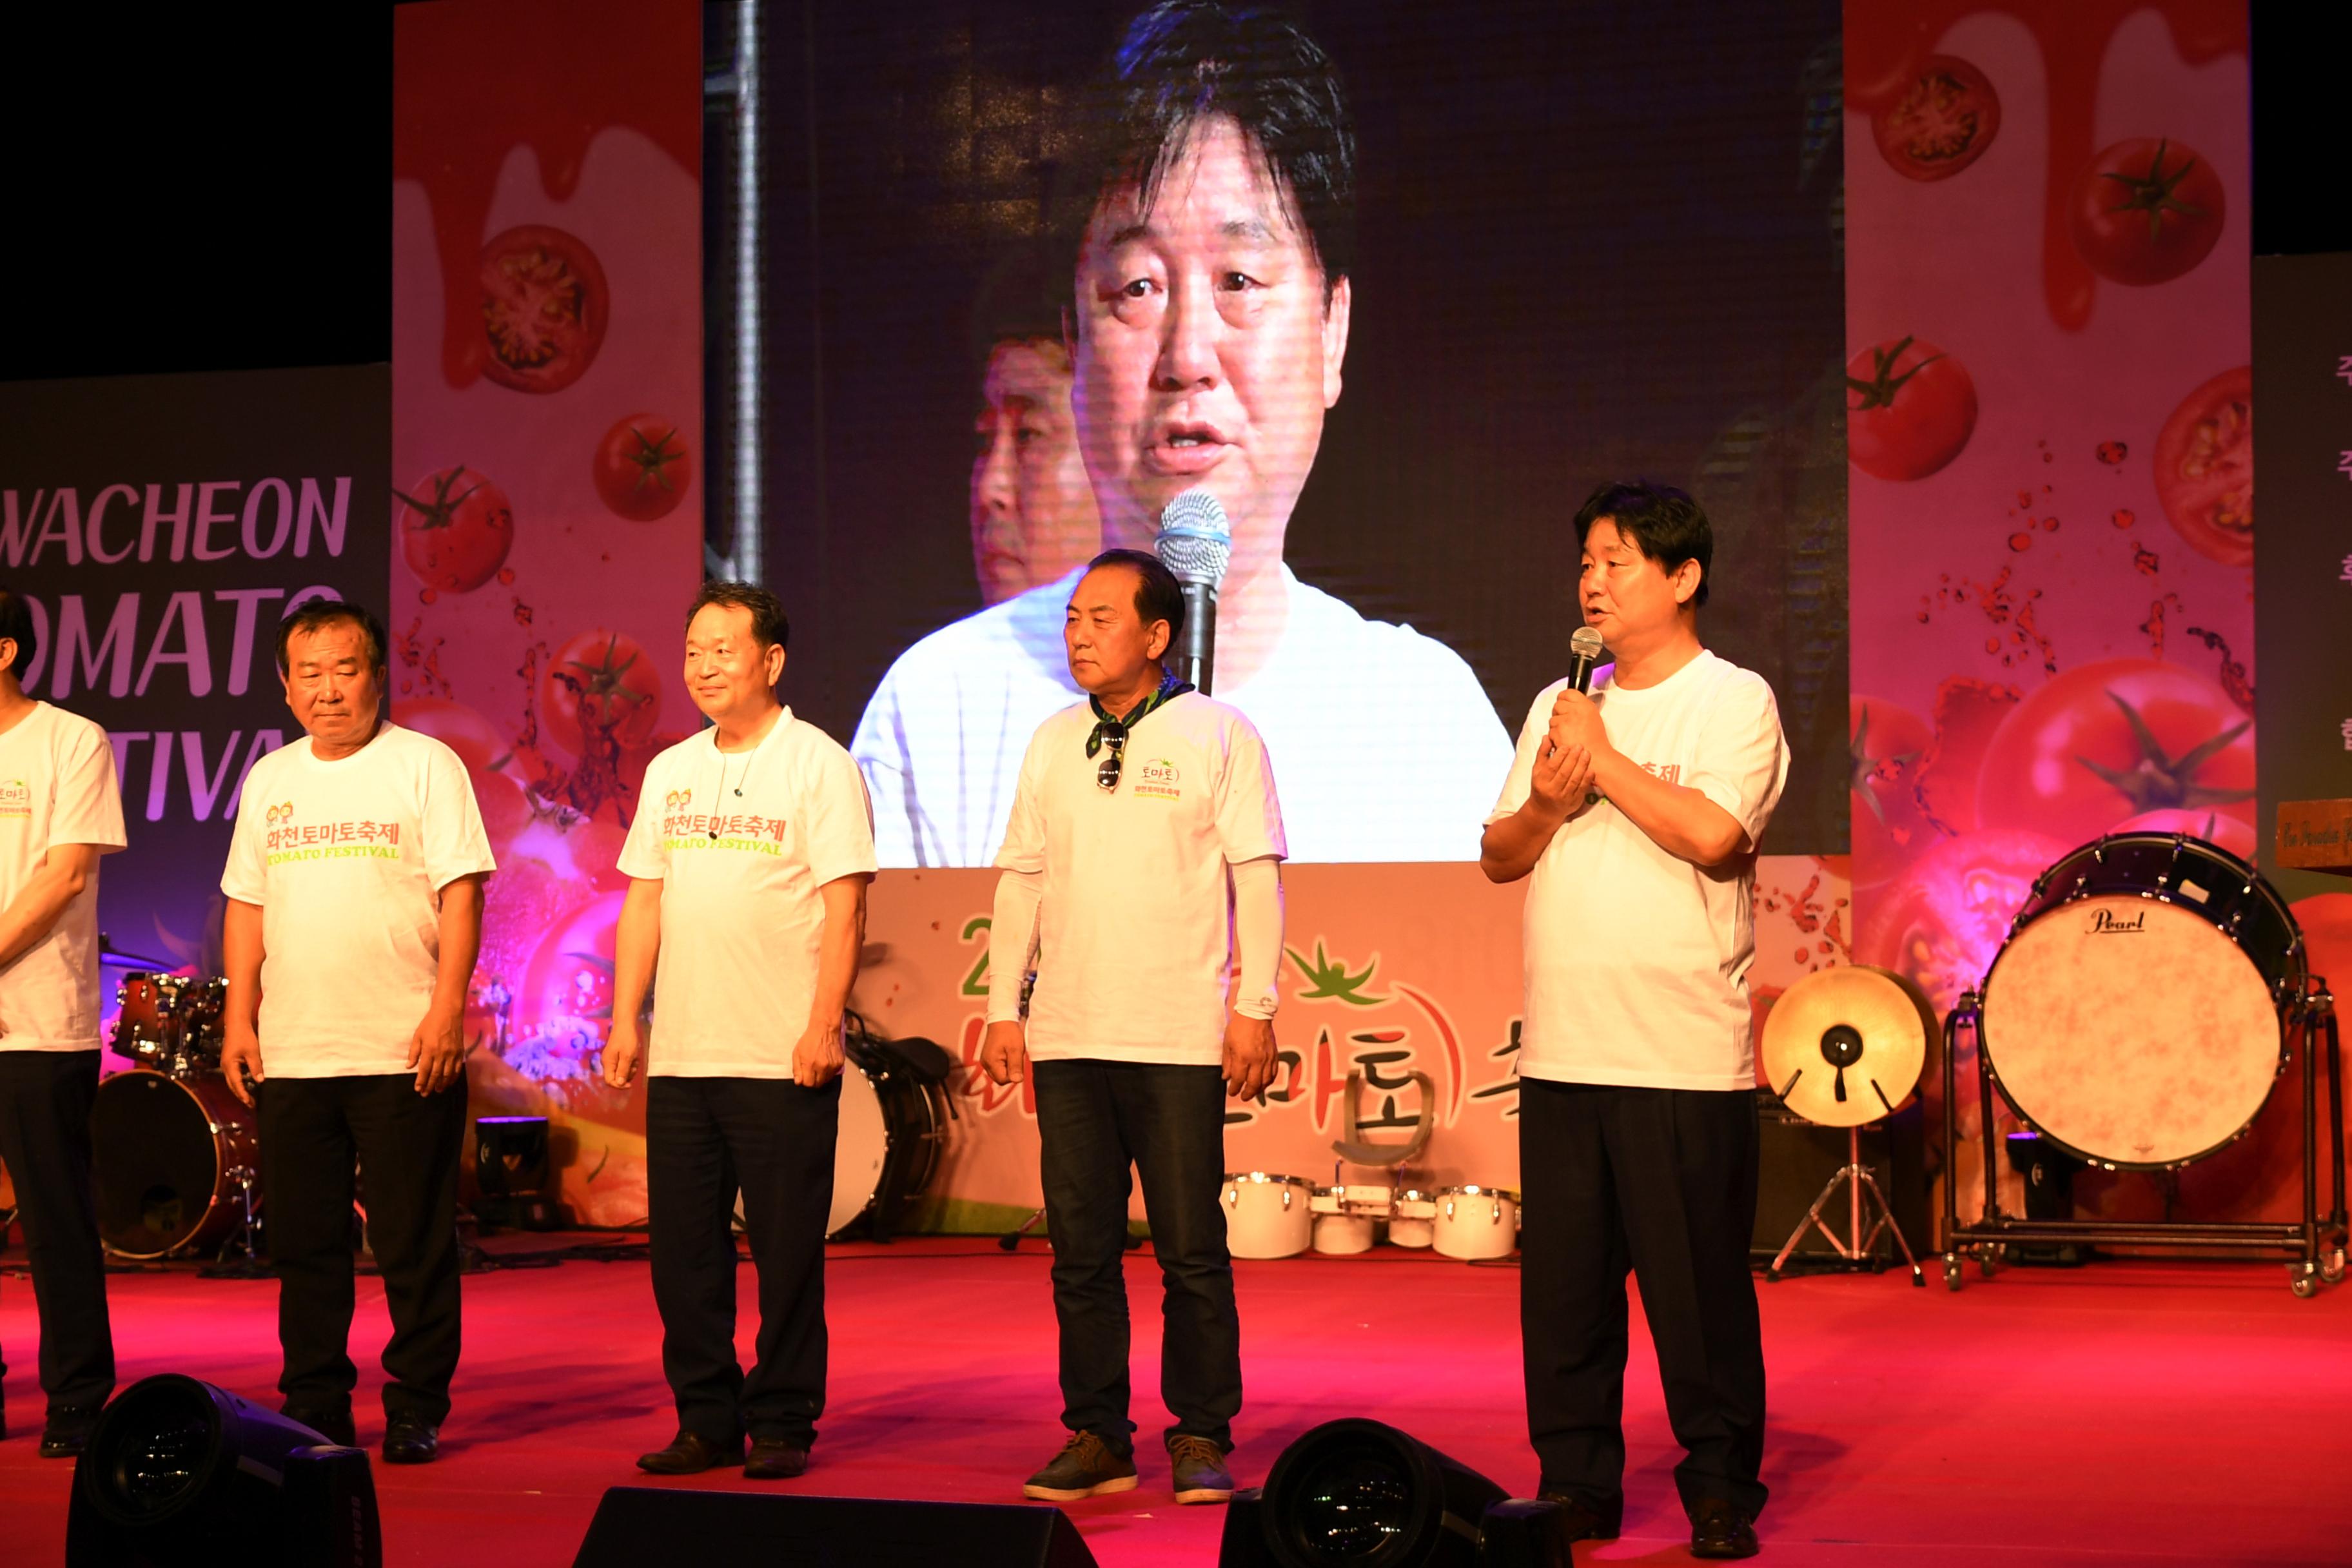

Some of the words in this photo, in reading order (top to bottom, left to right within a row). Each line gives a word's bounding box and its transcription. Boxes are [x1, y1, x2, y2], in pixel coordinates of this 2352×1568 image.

[266, 820, 400, 850] 화천토마토축제
[663, 814, 787, 842] 화천토마토축제
[267, 849, 320, 866] TOMATO
[324, 845, 400, 859] FESTIVAL
[710, 838, 783, 856] FESTIVAL
[2084, 908, 2145, 934] Pearl
